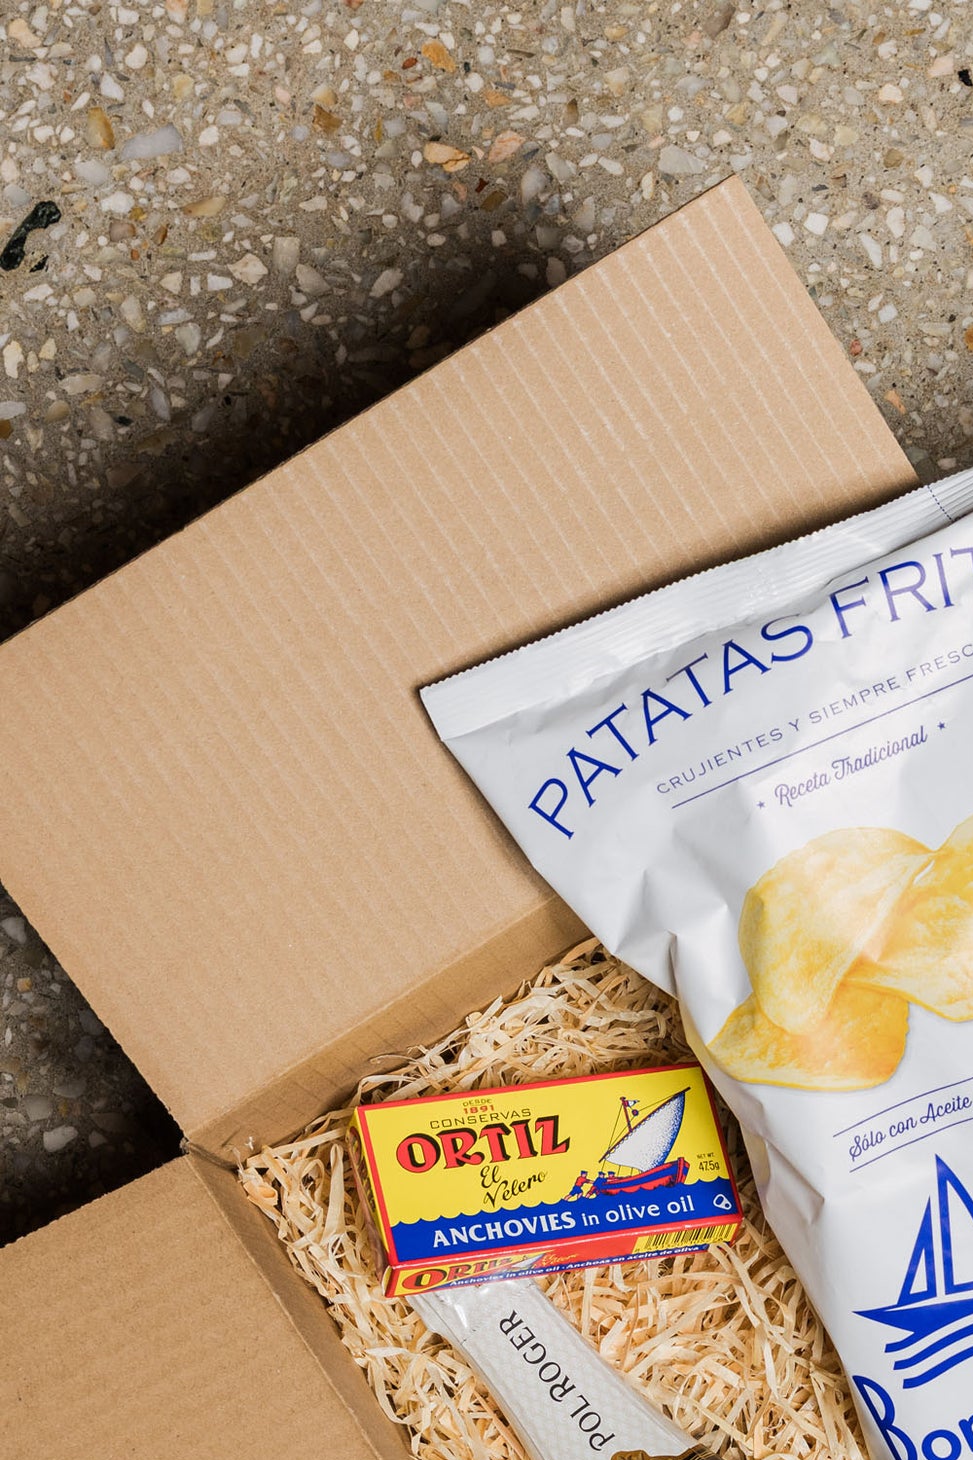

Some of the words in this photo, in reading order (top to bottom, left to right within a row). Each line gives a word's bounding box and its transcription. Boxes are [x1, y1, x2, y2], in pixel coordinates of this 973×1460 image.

[528, 614, 814, 839] PATATAS
[657, 729, 783, 794] CRUJIENTES
[789, 721, 800, 732] Y
[809, 677, 902, 726] SIEMPRE
[775, 772, 831, 806] Receta
[831, 726, 928, 786] Tradicional
[430, 1108, 532, 1130] CONSERVAS
[464, 1105, 495, 1114] 1891
[849, 1128, 885, 1162] Sólo
[890, 1116, 917, 1137] con
[920, 1095, 972, 1123] Aceite
[396, 1114, 570, 1174] ORTIZ
[480, 1165, 501, 1189] El
[483, 1170, 548, 1208] Velero
[433, 1212, 576, 1248] ANCHOVIES
[583, 1214, 599, 1227] in
[606, 1201, 660, 1223] olive
[667, 1195, 695, 1214] oil
[450, 1274, 503, 1286] Anchovies
[518, 1268, 544, 1276] olive
[499, 1309, 576, 1404] ROGER
[569, 1394, 616, 1451] POL
